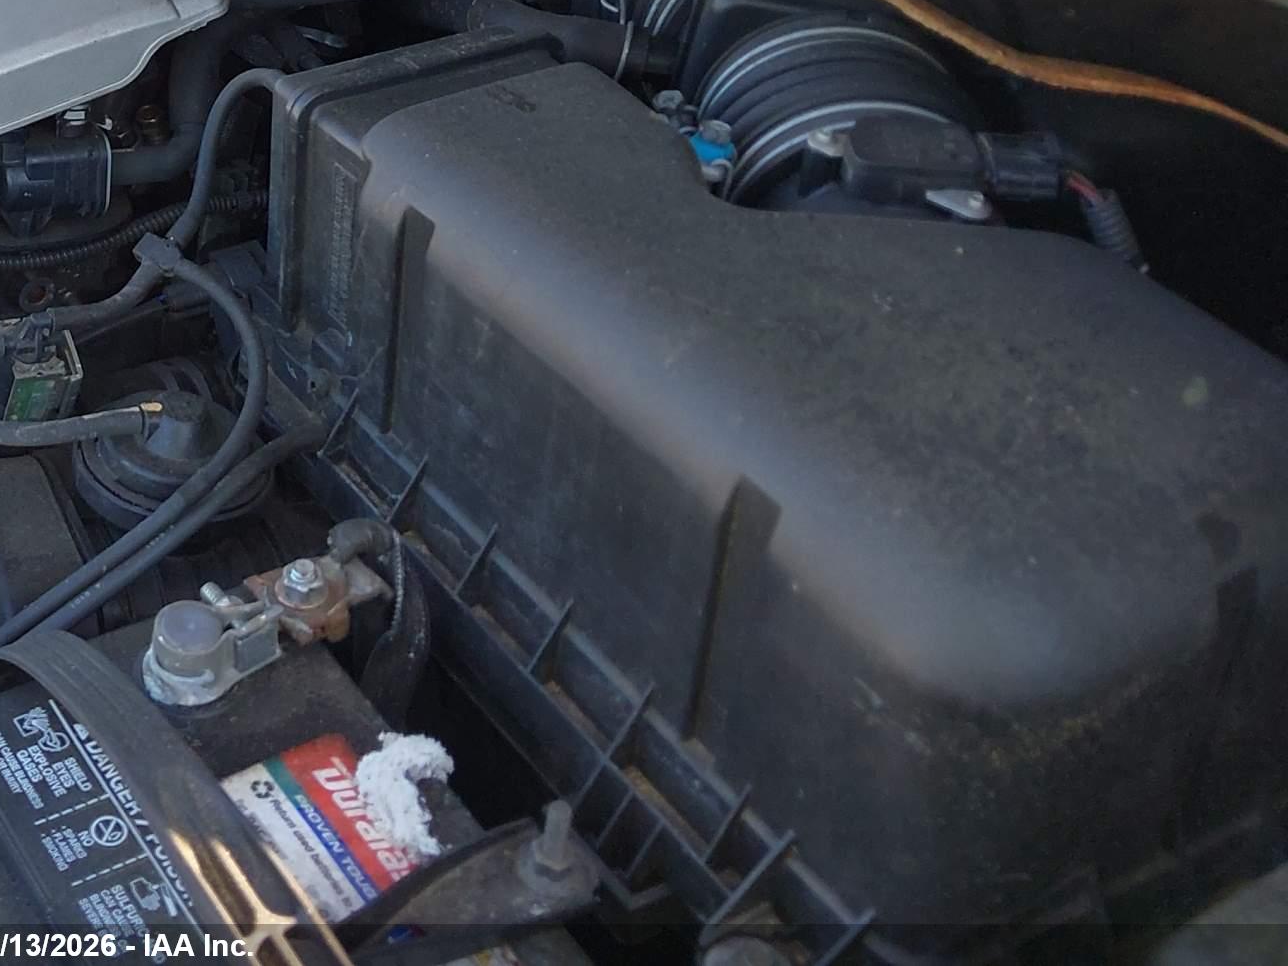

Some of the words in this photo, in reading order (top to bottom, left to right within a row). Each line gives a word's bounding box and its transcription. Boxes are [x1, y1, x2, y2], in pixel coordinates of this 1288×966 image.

[1, 747, 20, 771] CAUSE
[17, 749, 43, 783] GASES
[27, 745, 67, 797] EXPLOSIVE
[52, 761, 75, 788] EYES
[64, 757, 92, 792] SHIELD
[85, 741, 142, 816] DANGER
[78, 830, 94, 846] NO
[295, 794, 344, 854] PROVEN
[41, 836, 69, 871] SMOKING
[53, 832, 76, 862] FLAMES
[63, 828, 88, 858] SPARKS
[270, 796, 296, 829] Return
[293, 830, 314, 853] used
[310, 851, 345, 896] batteries
[78, 898, 104, 930] SEVERE
[100, 889, 117, 908] CAN
[110, 884, 150, 937] SULFURIC
